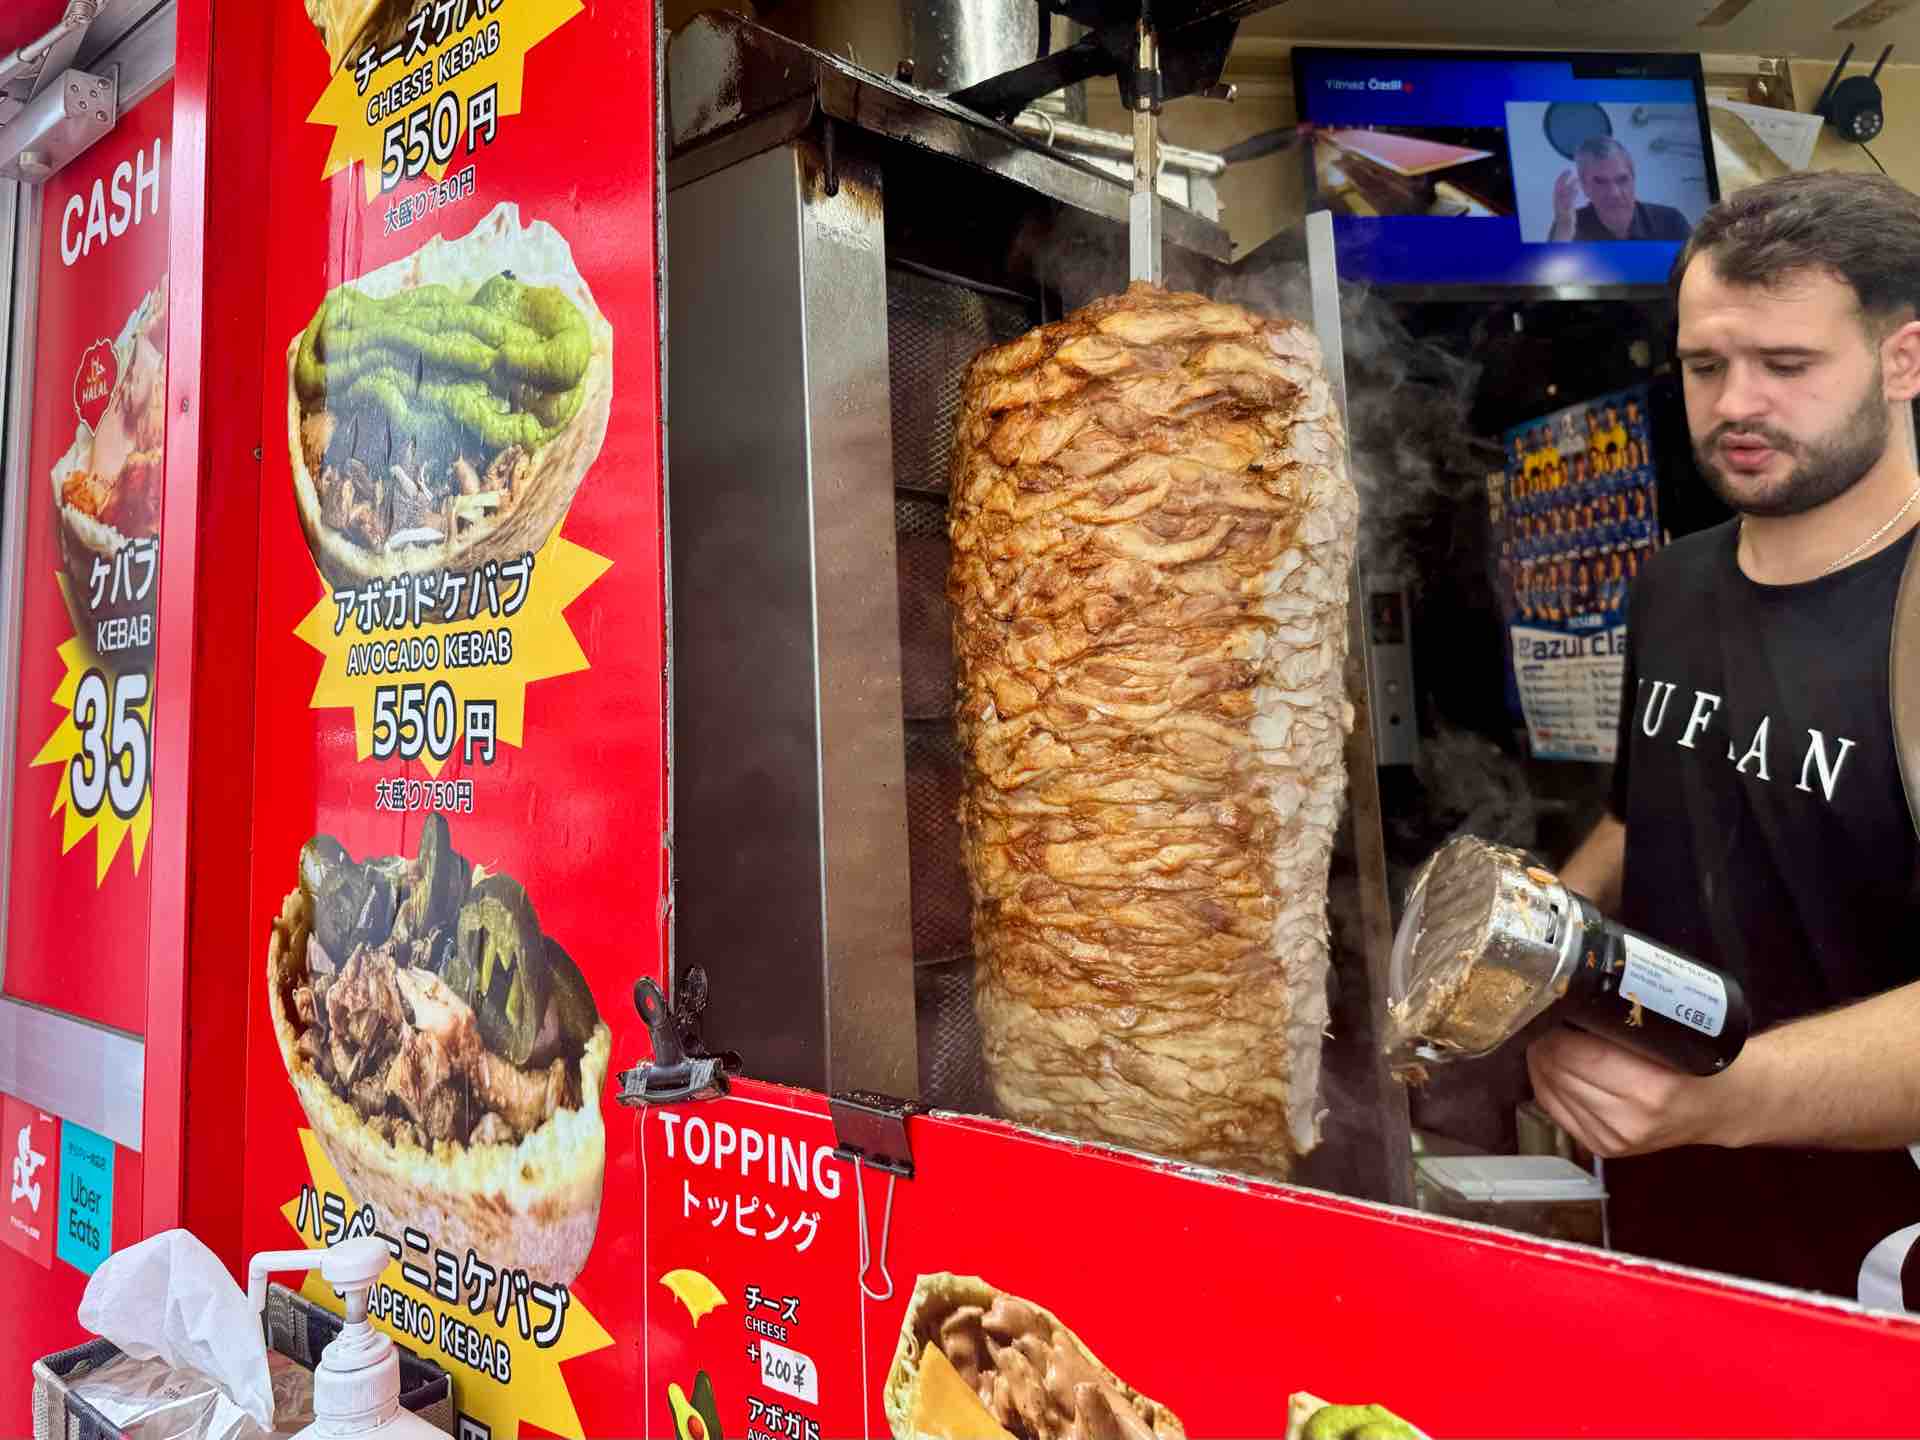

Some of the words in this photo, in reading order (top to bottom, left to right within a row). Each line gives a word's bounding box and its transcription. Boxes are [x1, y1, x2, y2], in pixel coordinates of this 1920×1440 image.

[367, 62, 432, 126] CHEESE
[438, 21, 500, 85] KEBAB
[61, 138, 161, 267] CASH
[384, 165, 476, 237] 大盛り750円
[88, 534, 159, 611] ケバブ
[333, 552, 536, 635] アボガドケバブ
[96, 613, 152, 653] KEBAB
[346, 634, 440, 677] AVOCADO
[443, 627, 513, 670] KEBAB
[69, 666, 151, 821] 35
[375, 777, 474, 813] 大盛り750円
[658, 1111, 841, 1200] TOPPING
[70, 1171, 101, 1213] Uber
[683, 1179, 822, 1252] トッピング
[68, 1208, 100, 1251] Eats
[337, 1284, 435, 1343] APENO
[440, 1315, 512, 1384] KEBAB
[744, 1315, 788, 1342] CHEESE
[745, 1286, 801, 1325] チーズ
[747, 1396, 821, 1440] アボガド
